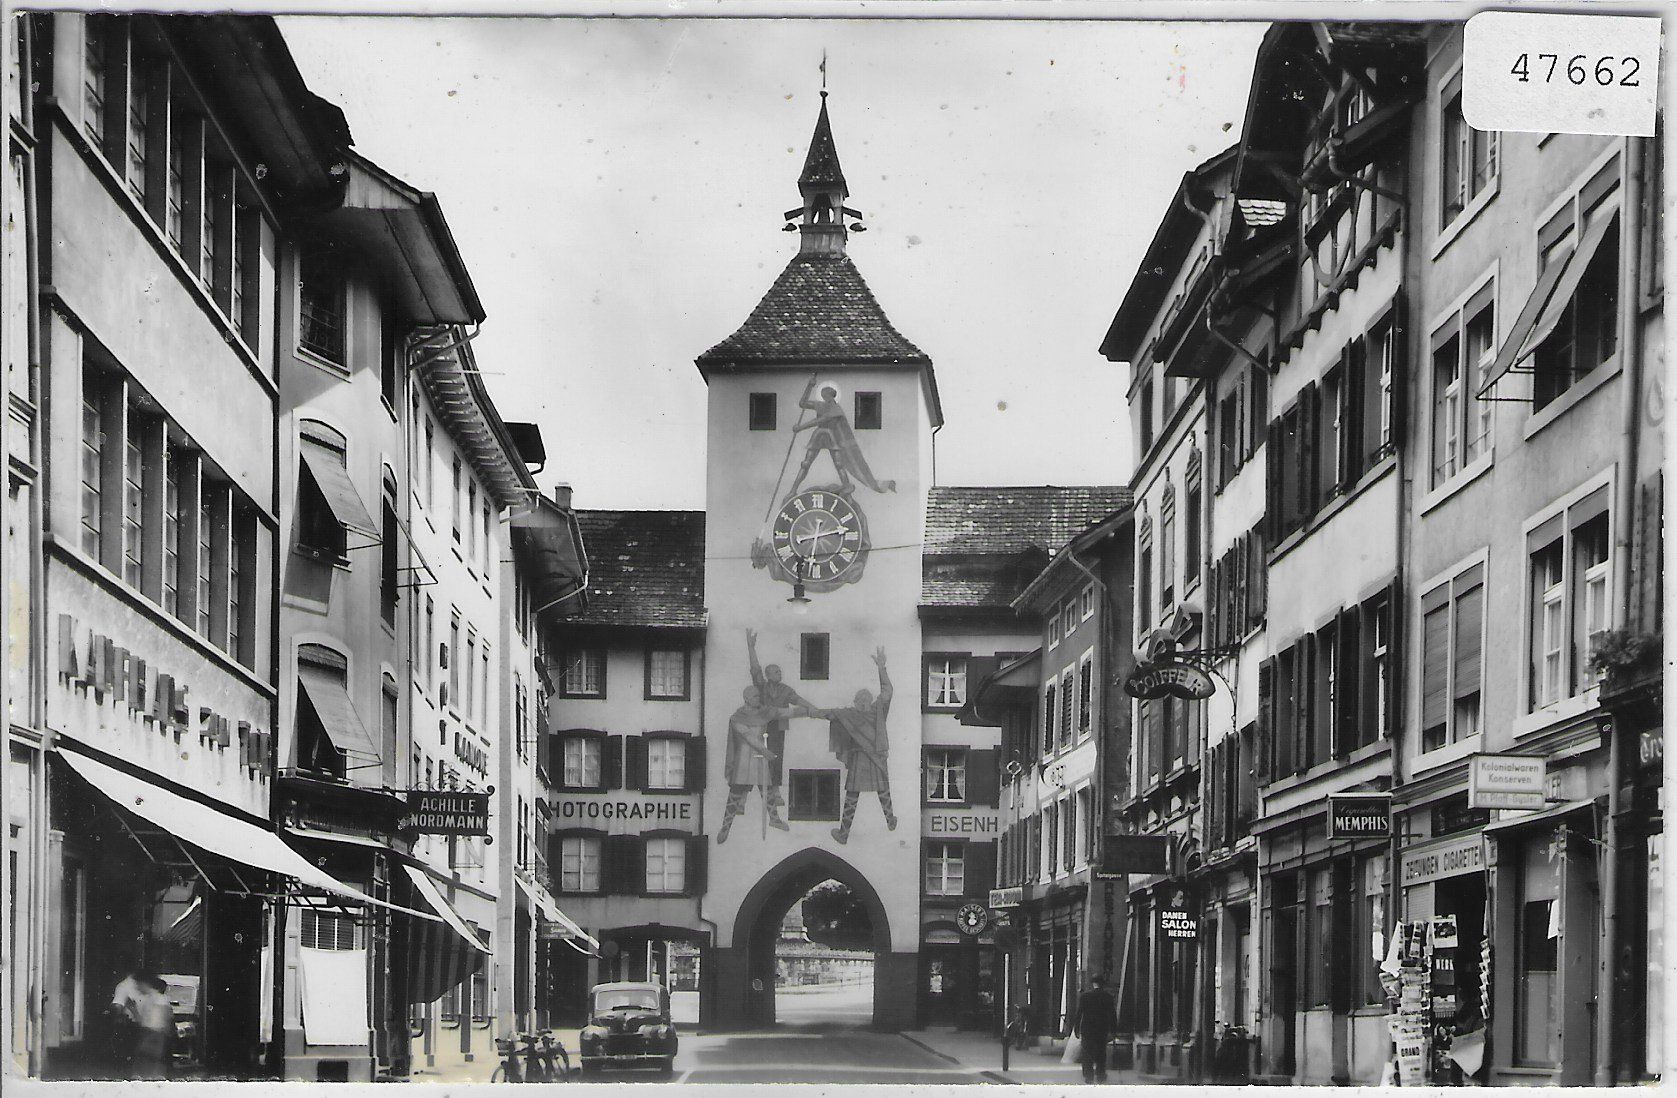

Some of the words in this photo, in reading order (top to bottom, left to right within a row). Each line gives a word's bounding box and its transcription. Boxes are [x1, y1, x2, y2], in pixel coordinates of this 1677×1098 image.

[1481, 762, 1539, 773] Kolonialwaren
[1488, 773, 1532, 784] Konserven
[420, 797, 476, 814] ACHILLE
[550, 801, 691, 819] HOTOGRAPHIE
[410, 813, 484, 829] NORDMANN
[931, 816, 998, 832] EISENH
[1335, 816, 1389, 831] MEMPHIS
[1406, 855, 1440, 880] ZEITUNGEN
[1443, 846, 1485, 872] CIGARETTEN
[1162, 911, 1187, 920] DAMEN
[1161, 919, 1197, 930] SALON
[1168, 930, 1196, 938] HERREN
